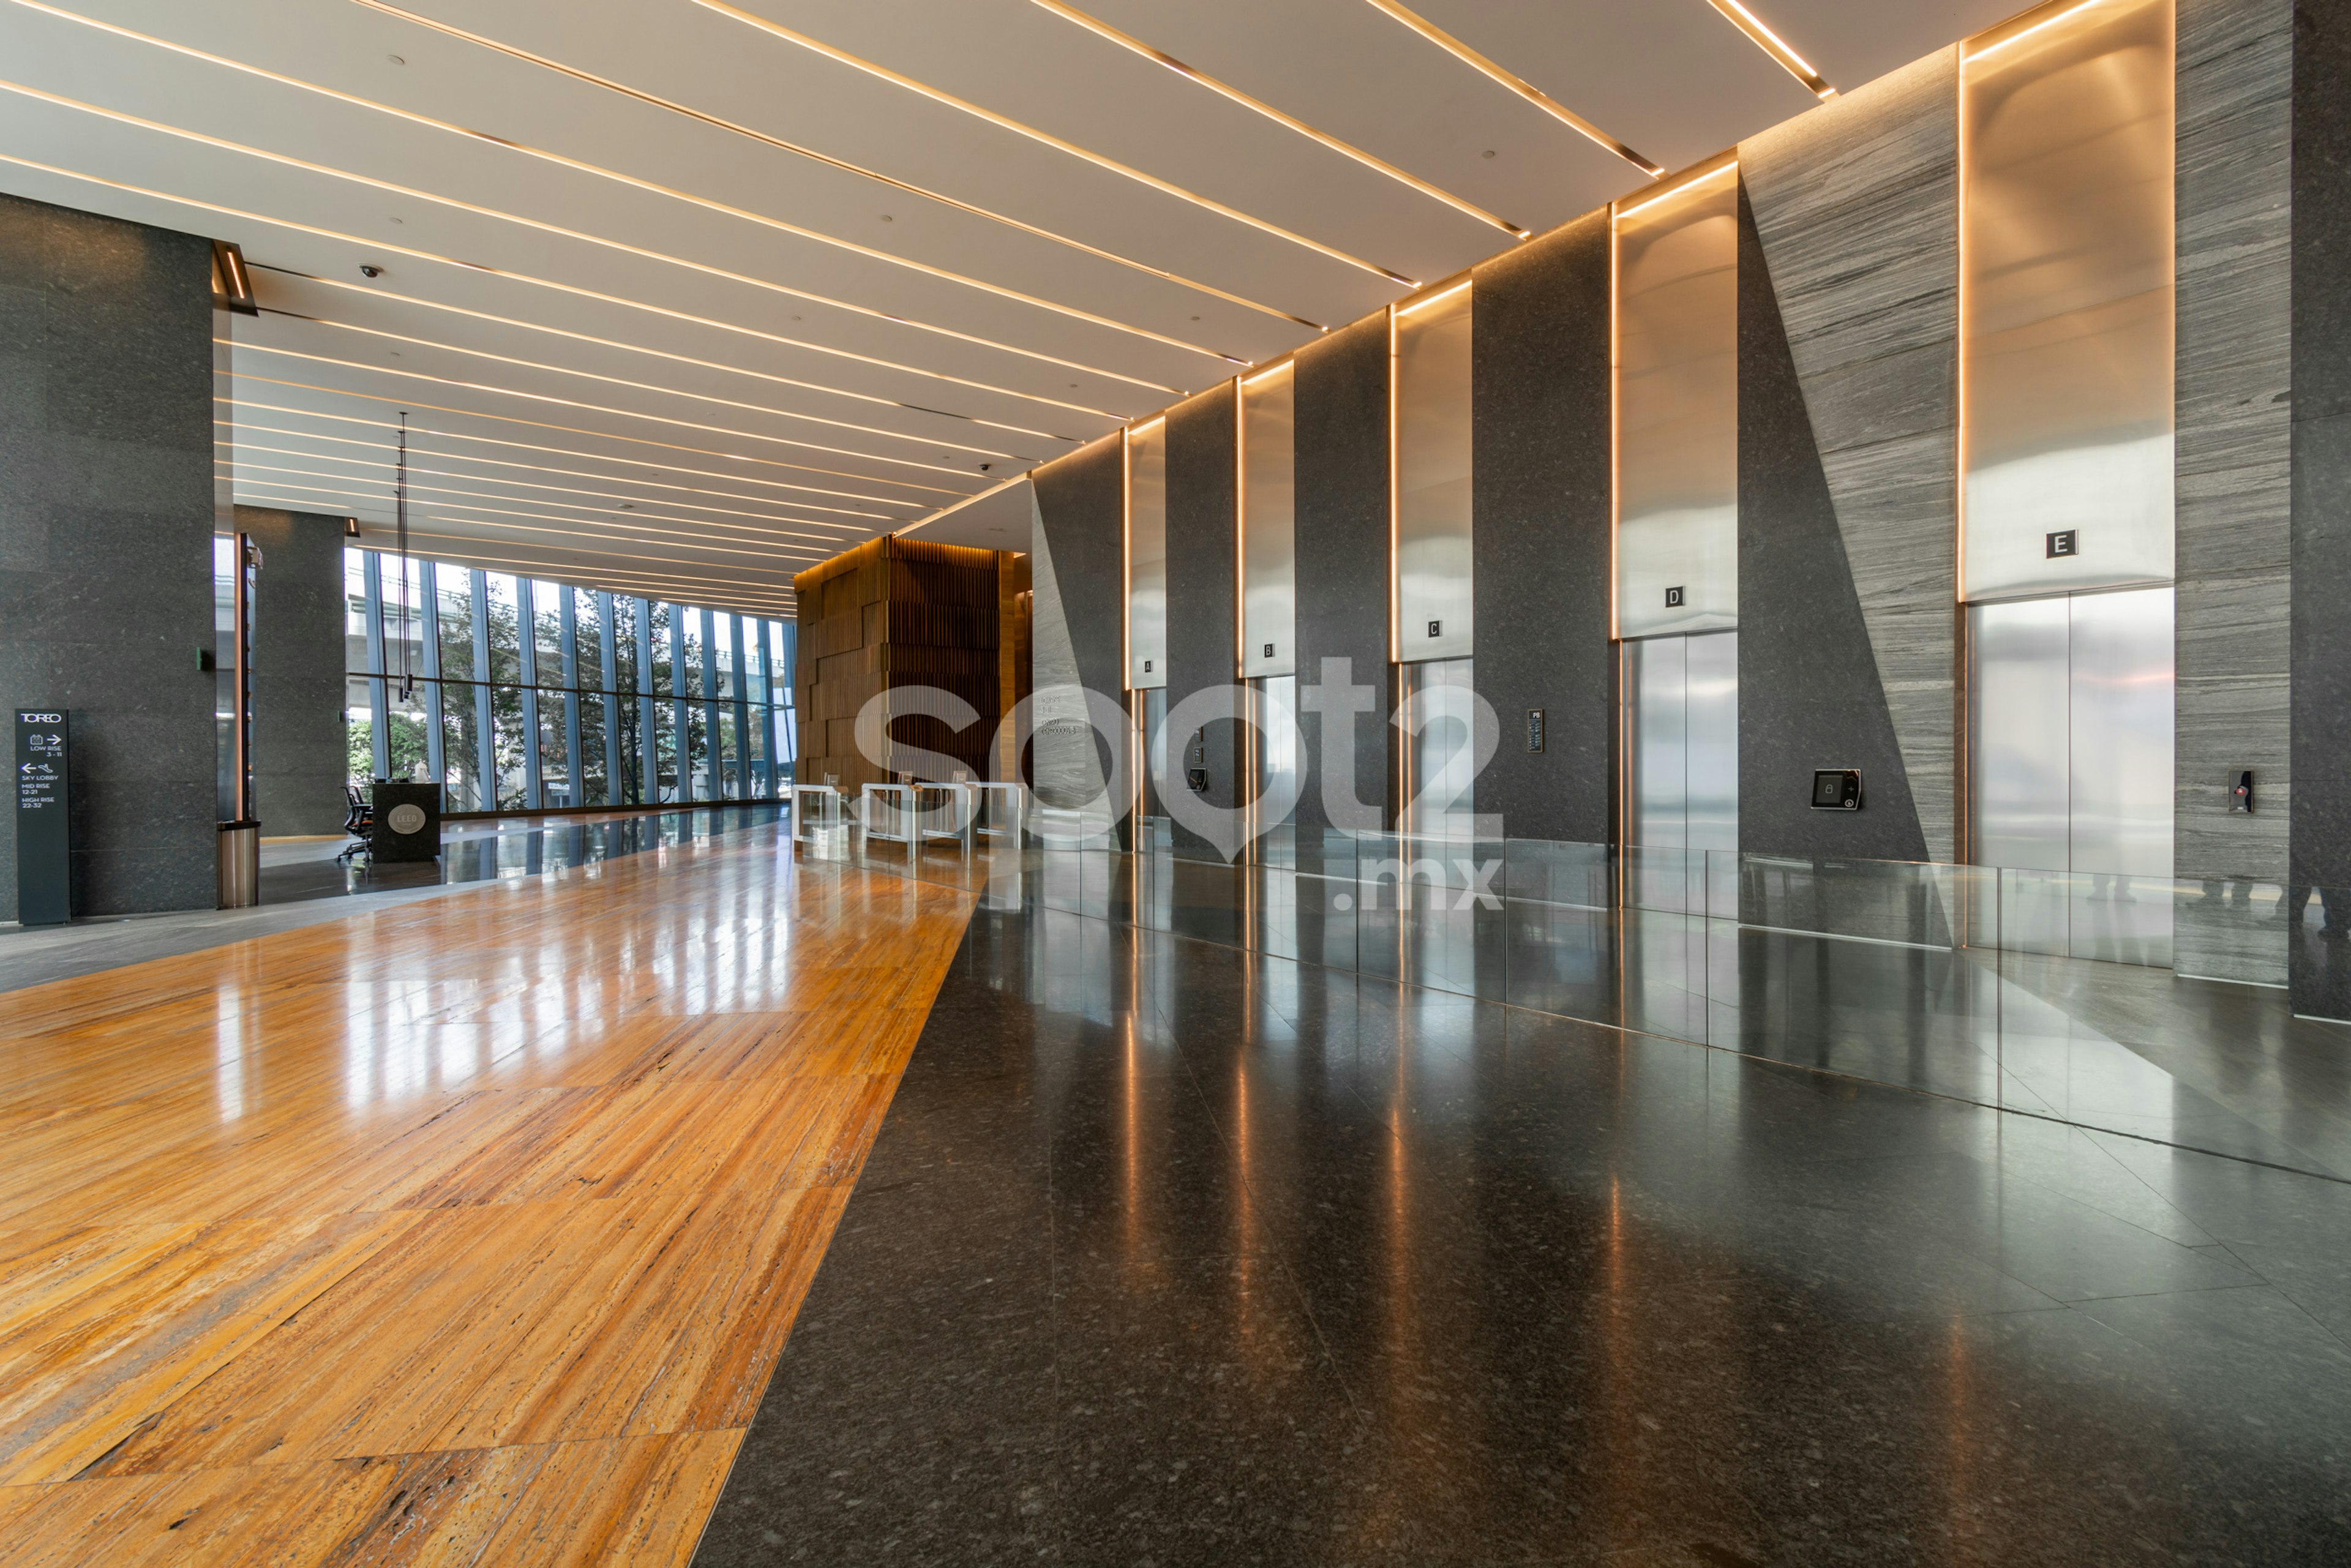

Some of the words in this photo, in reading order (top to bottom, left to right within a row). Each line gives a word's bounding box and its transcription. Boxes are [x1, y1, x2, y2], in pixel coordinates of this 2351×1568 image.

[2055, 535, 2068, 553] E
[1670, 590, 1679, 604] D
[1431, 623, 1437, 634] C
[1265, 645, 1271, 655] B
[20, 713, 62, 722] TOREO
